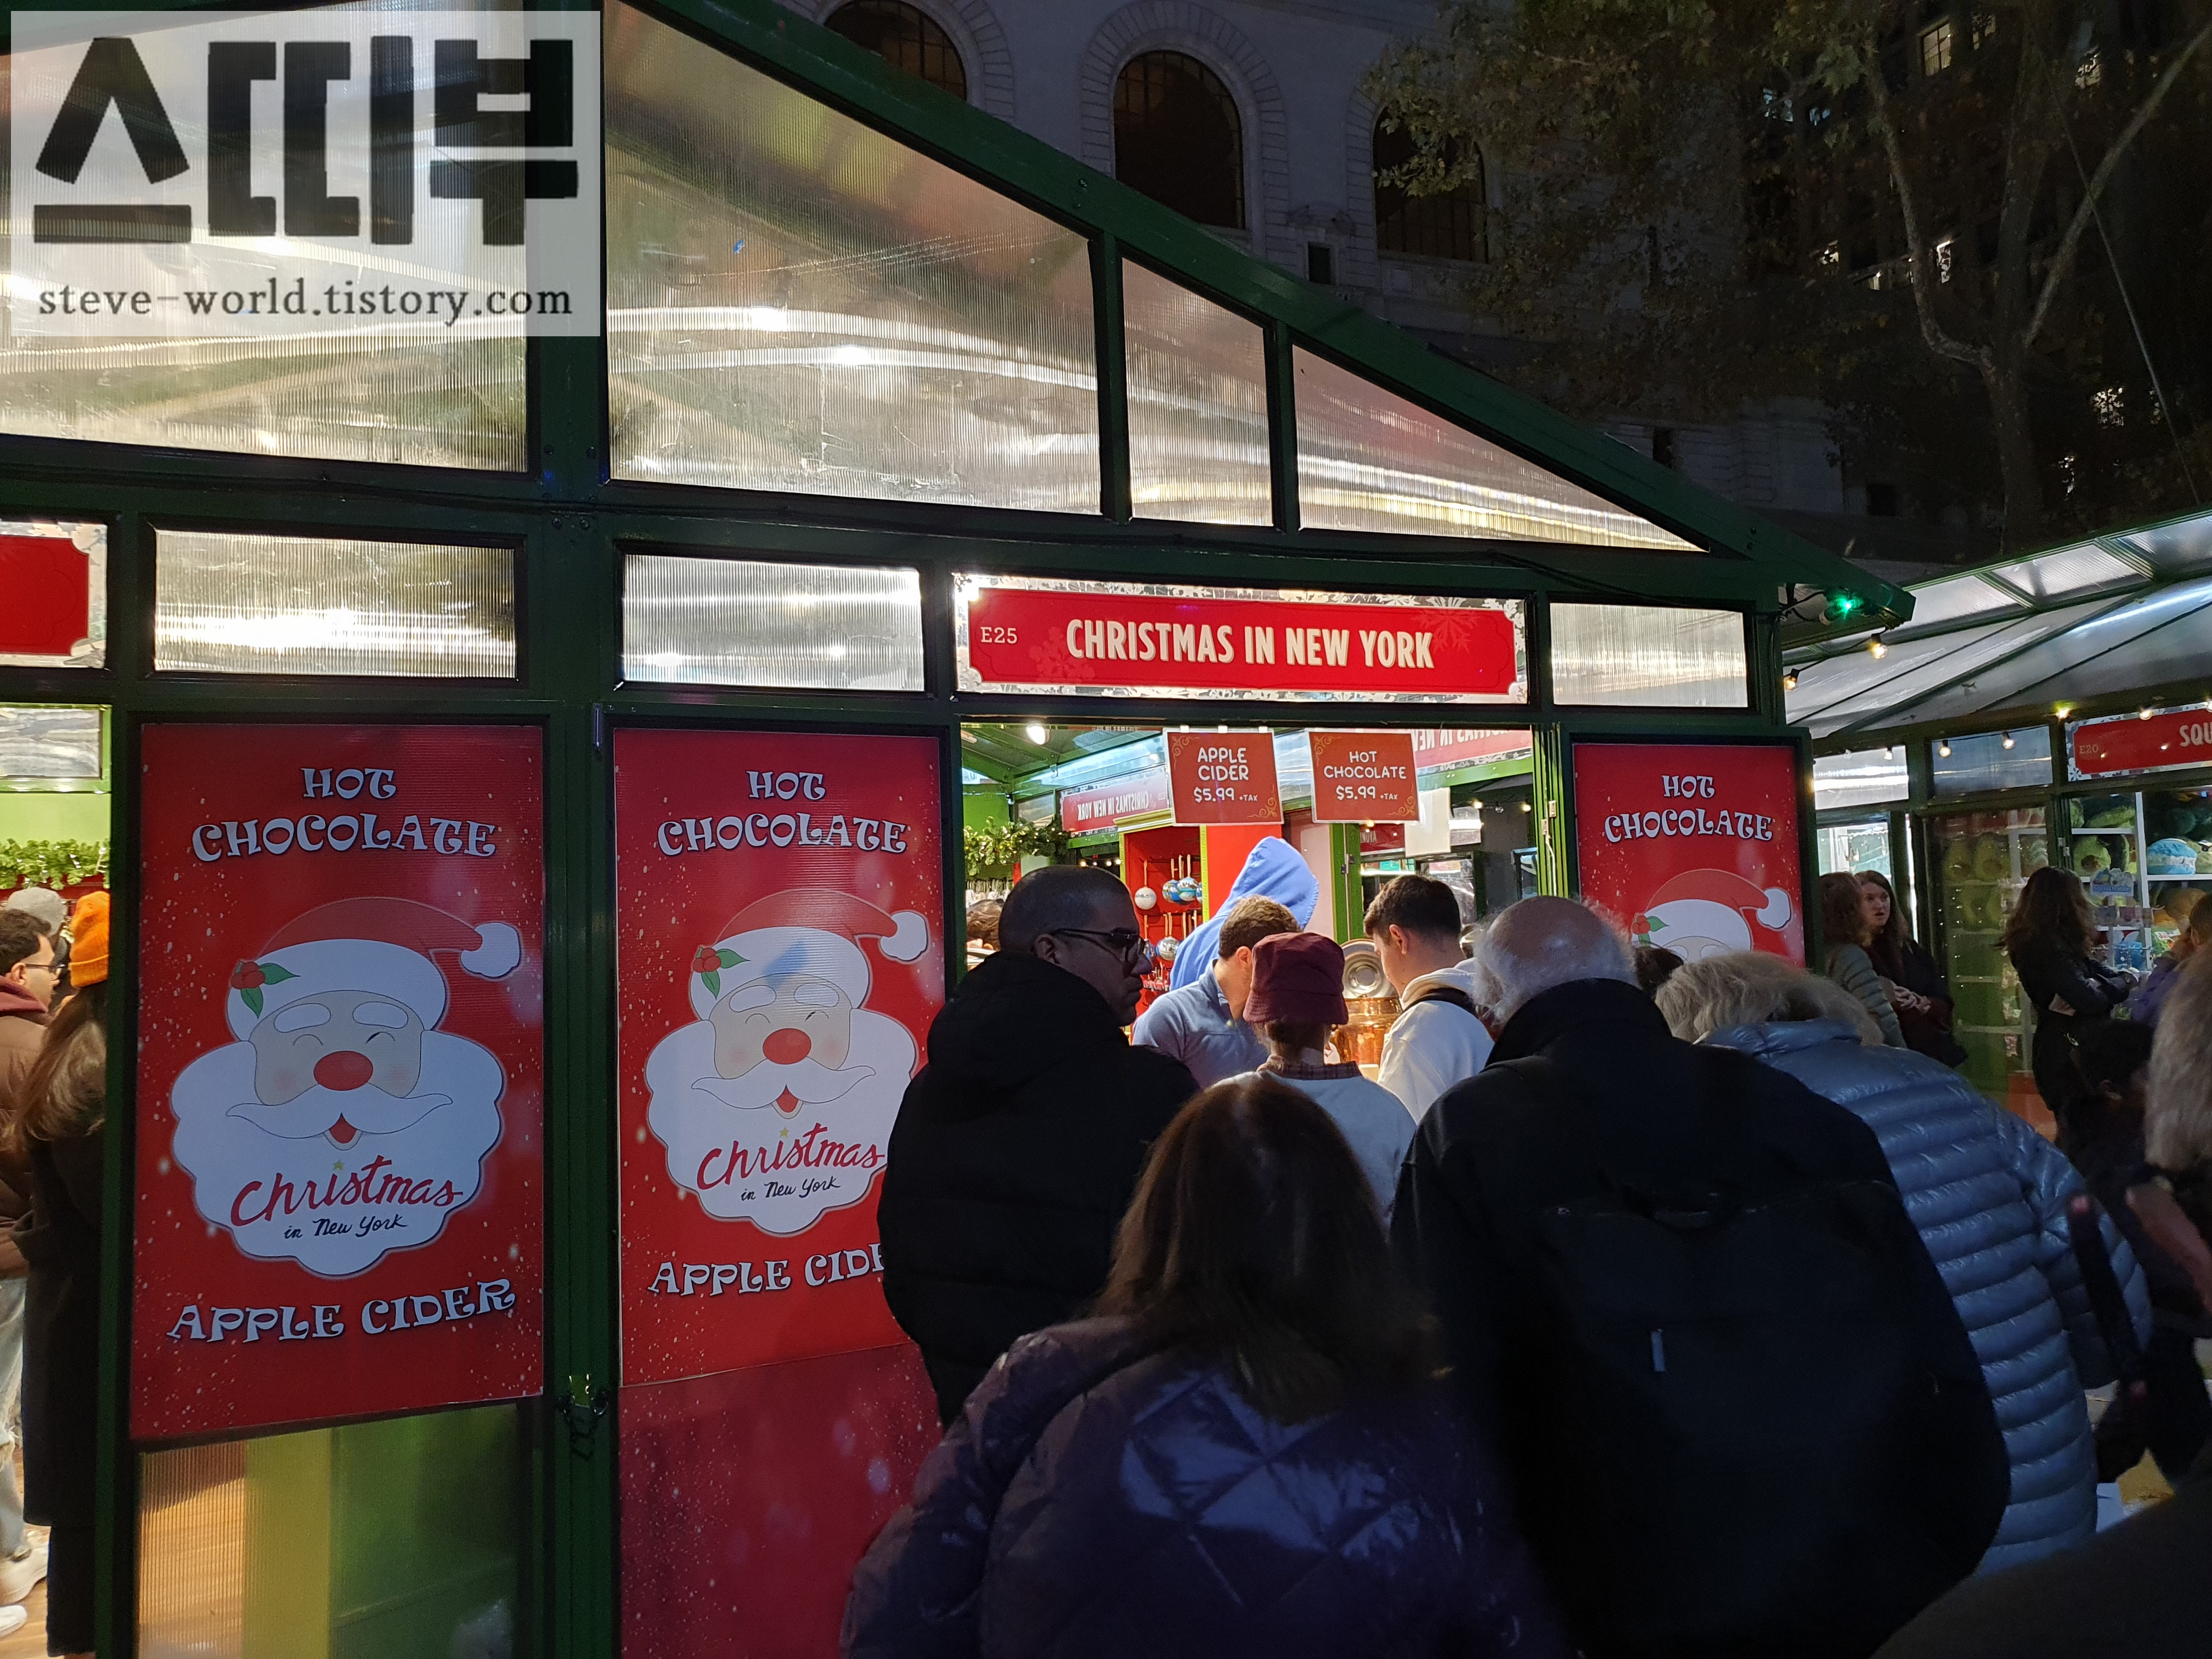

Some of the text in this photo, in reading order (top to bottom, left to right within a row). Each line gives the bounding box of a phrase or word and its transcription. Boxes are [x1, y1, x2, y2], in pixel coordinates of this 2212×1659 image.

[980, 627, 1018, 644] E25
[1066, 619, 1435, 669] CHRISTMAS IN NEW YORK
[1197, 747, 1248, 764] APPLE
[1349, 751, 1377, 764] HOT
[2079, 744, 2098, 754] E20
[300, 768, 397, 799] HOT
[746, 770, 826, 800] HOT
[1198, 765, 1249, 781] CIDER
[1323, 765, 1407, 780] CHOCOLATE
[1193, 786, 1235, 803] $5.99
[1335, 785, 1398, 801] $5.99 +TAX
[1661, 775, 1716, 799] HOT
[192, 812, 496, 862] CHOCOLATE
[658, 812, 908, 856] CHOCOLATE
[1604, 808, 1774, 843] CHOCOLATE
[696, 1122, 885, 1190] Christmas
[230, 1155, 464, 1227] Christmas
[741, 1176, 841, 1201] in New York
[284, 1213, 408, 1239] in New York
[647, 1243, 884, 1297] APPLE CIDE
[166, 1278, 516, 1343] APPLE CIDER
